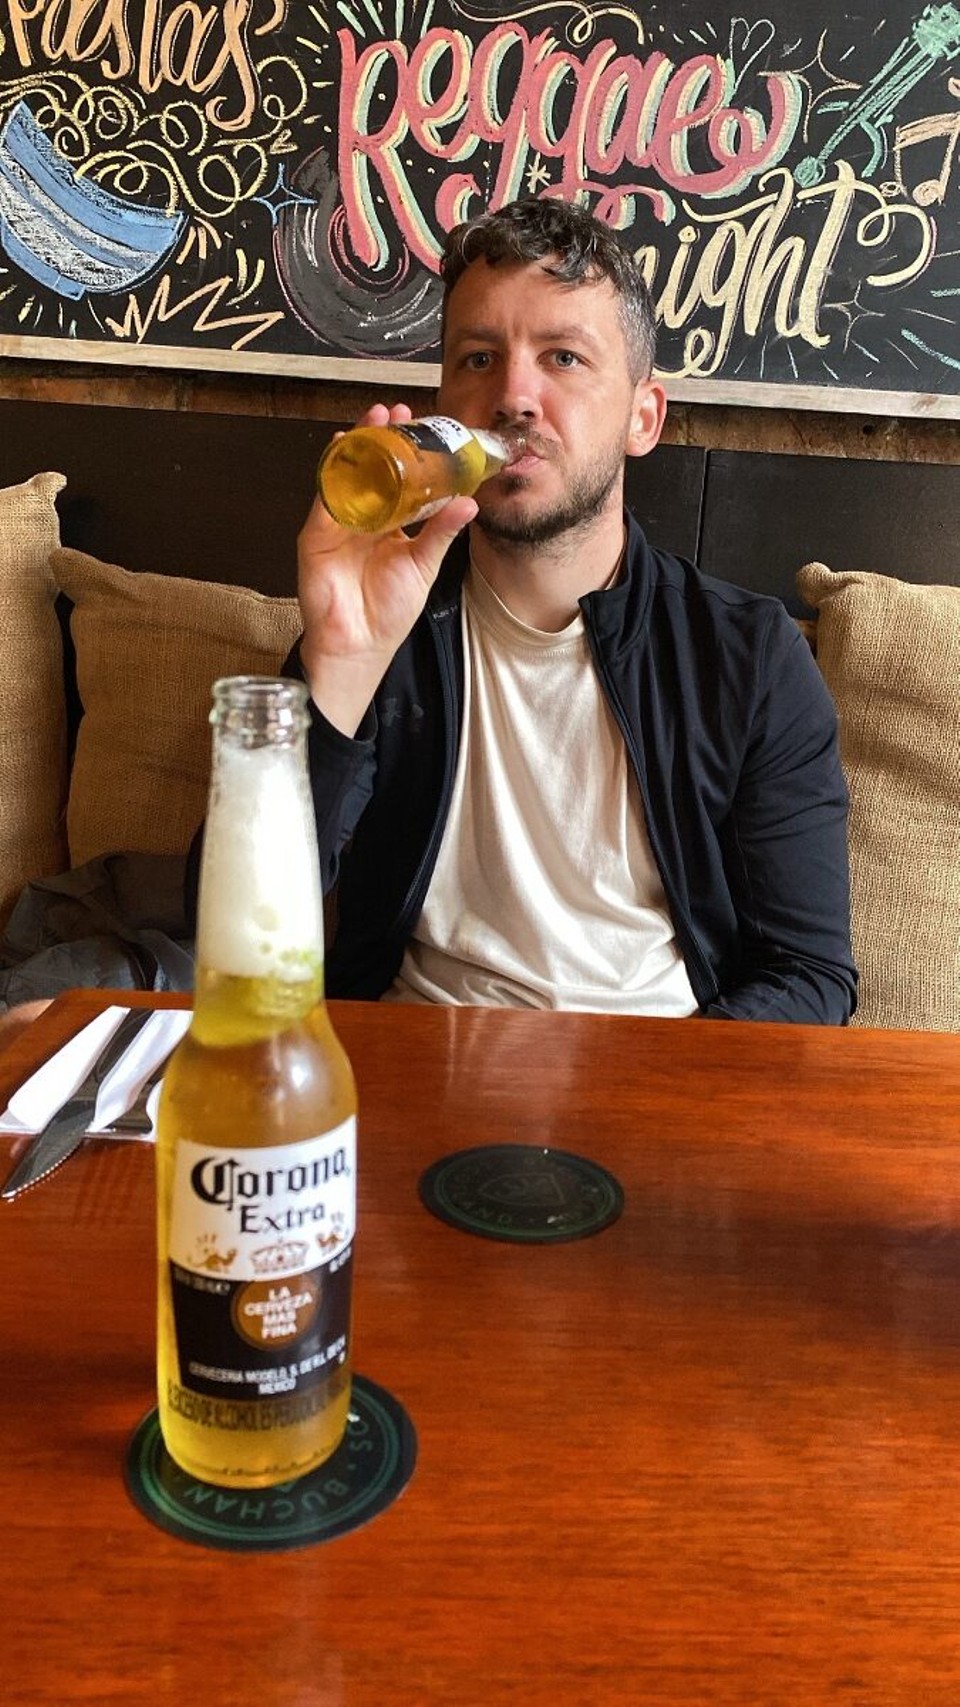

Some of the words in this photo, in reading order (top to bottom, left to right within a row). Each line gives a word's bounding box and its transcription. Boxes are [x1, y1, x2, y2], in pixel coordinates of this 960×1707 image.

[337, 22, 802, 273] Reggae
[191, 1147, 346, 1210] Corona
[240, 1204, 326, 1233] Extra
[244, 1292, 313, 1317] CERVEZA
[268, 1286, 291, 1301] LA
[260, 1321, 298, 1340] FINA
